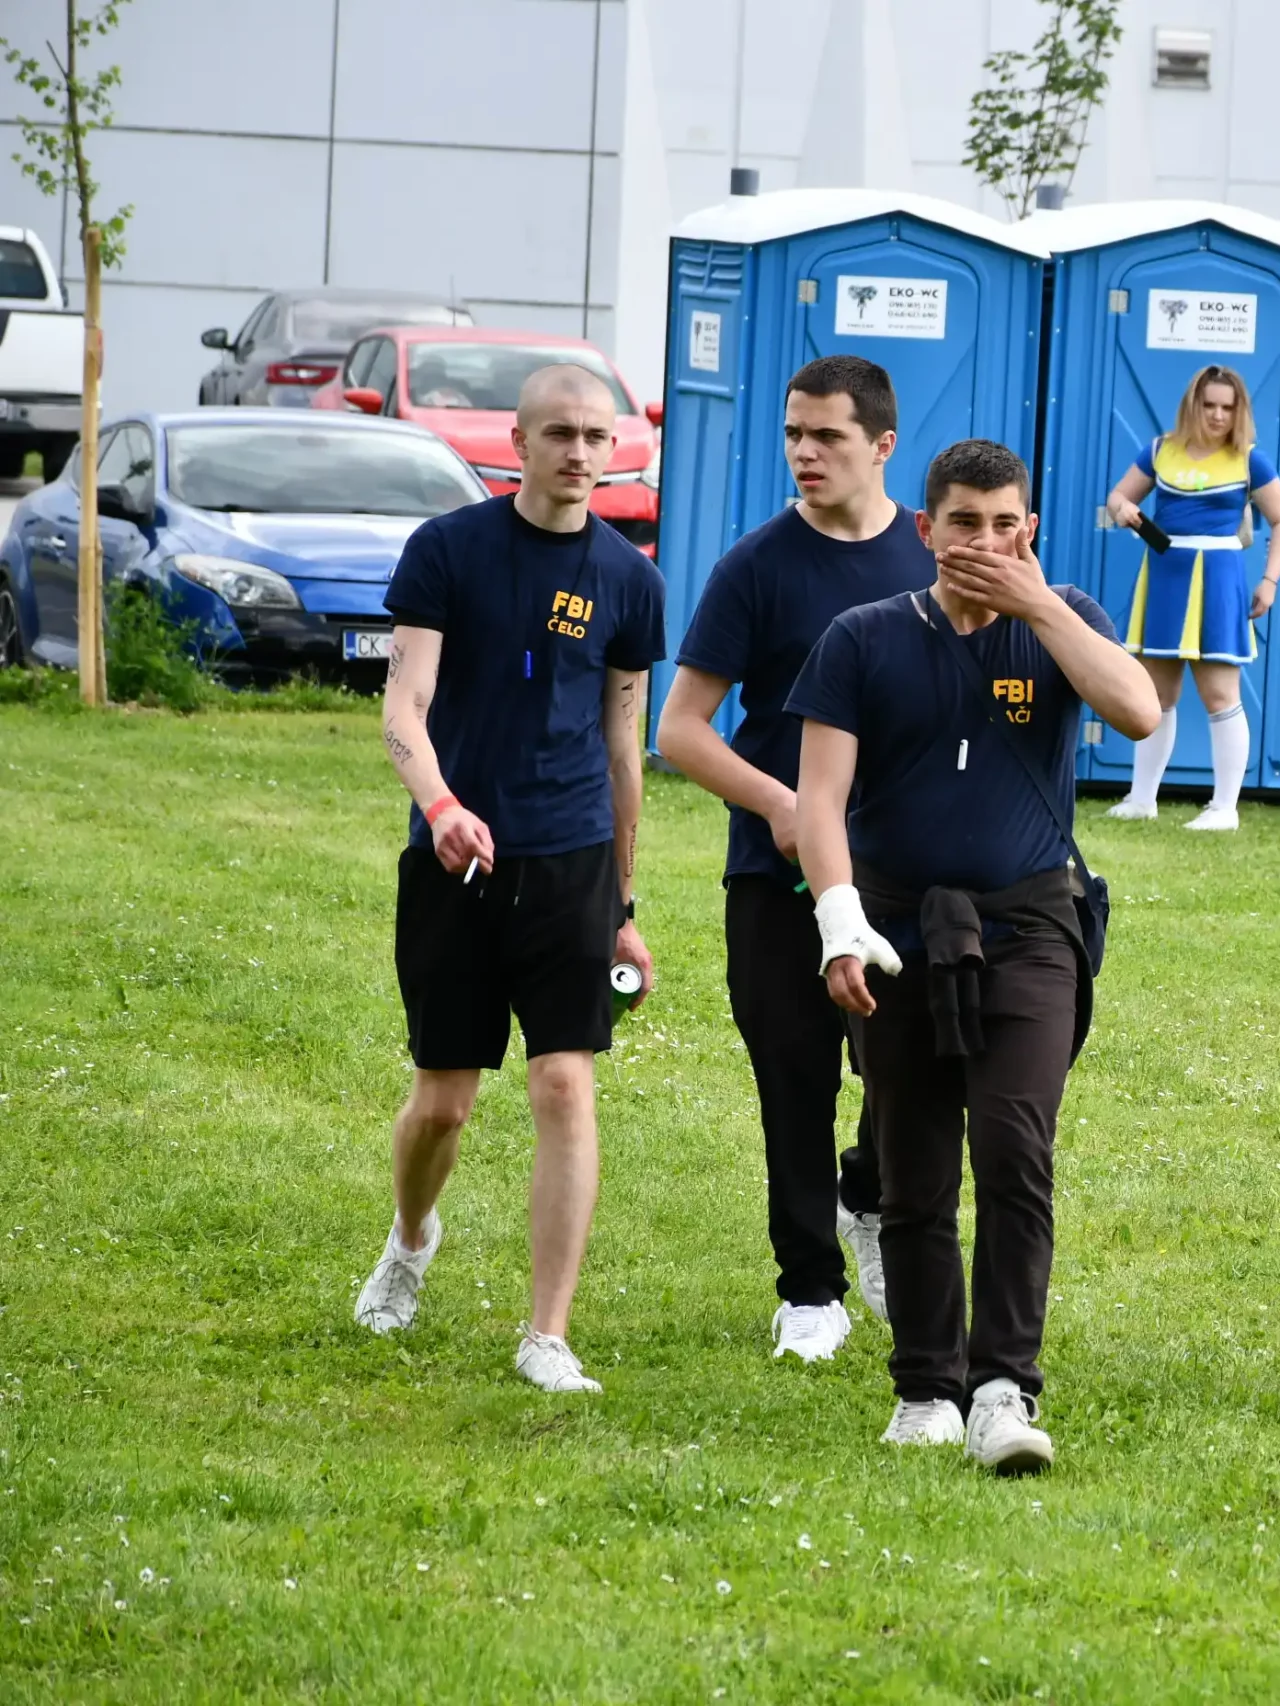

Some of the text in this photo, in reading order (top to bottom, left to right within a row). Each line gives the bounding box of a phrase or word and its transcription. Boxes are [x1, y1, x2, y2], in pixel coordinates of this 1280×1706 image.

[552, 591, 593, 622] FBI
[547, 615, 586, 639] ČELO
[359, 635, 381, 656] CK
[993, 679, 1033, 703] FBI
